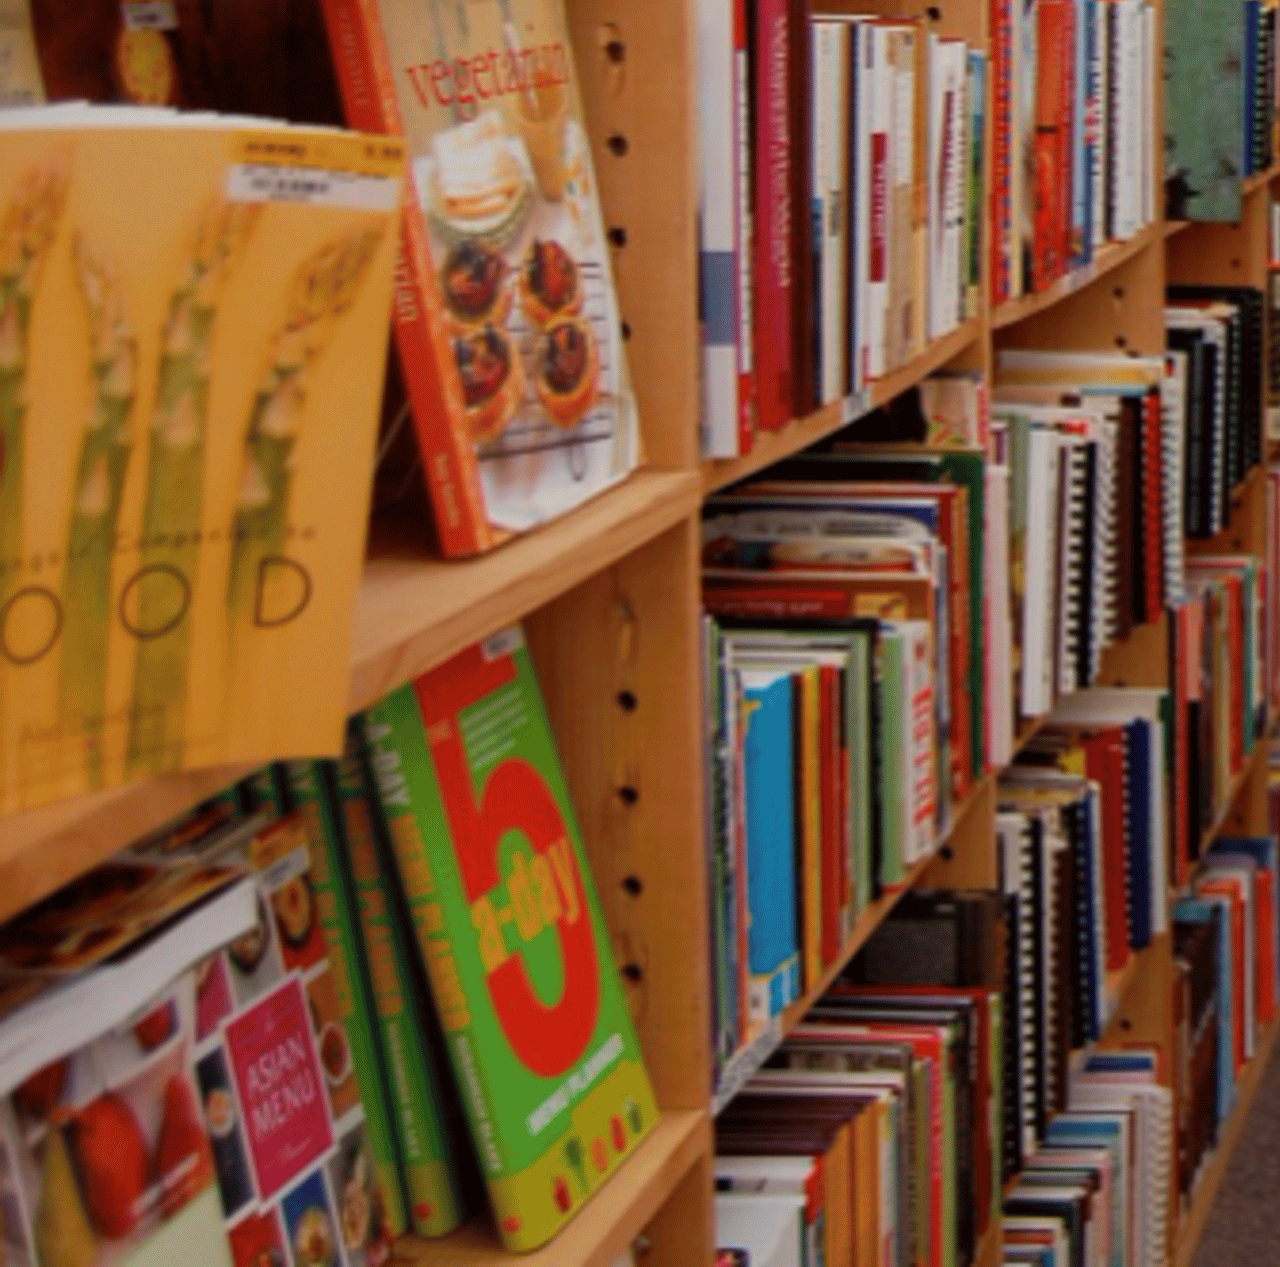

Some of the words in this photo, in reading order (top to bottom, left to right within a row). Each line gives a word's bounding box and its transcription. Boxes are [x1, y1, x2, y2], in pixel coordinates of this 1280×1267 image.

[472, 836, 580, 976] a-day
[244, 1028, 308, 1097] ASIAN
[251, 1067, 317, 1141] MENU
